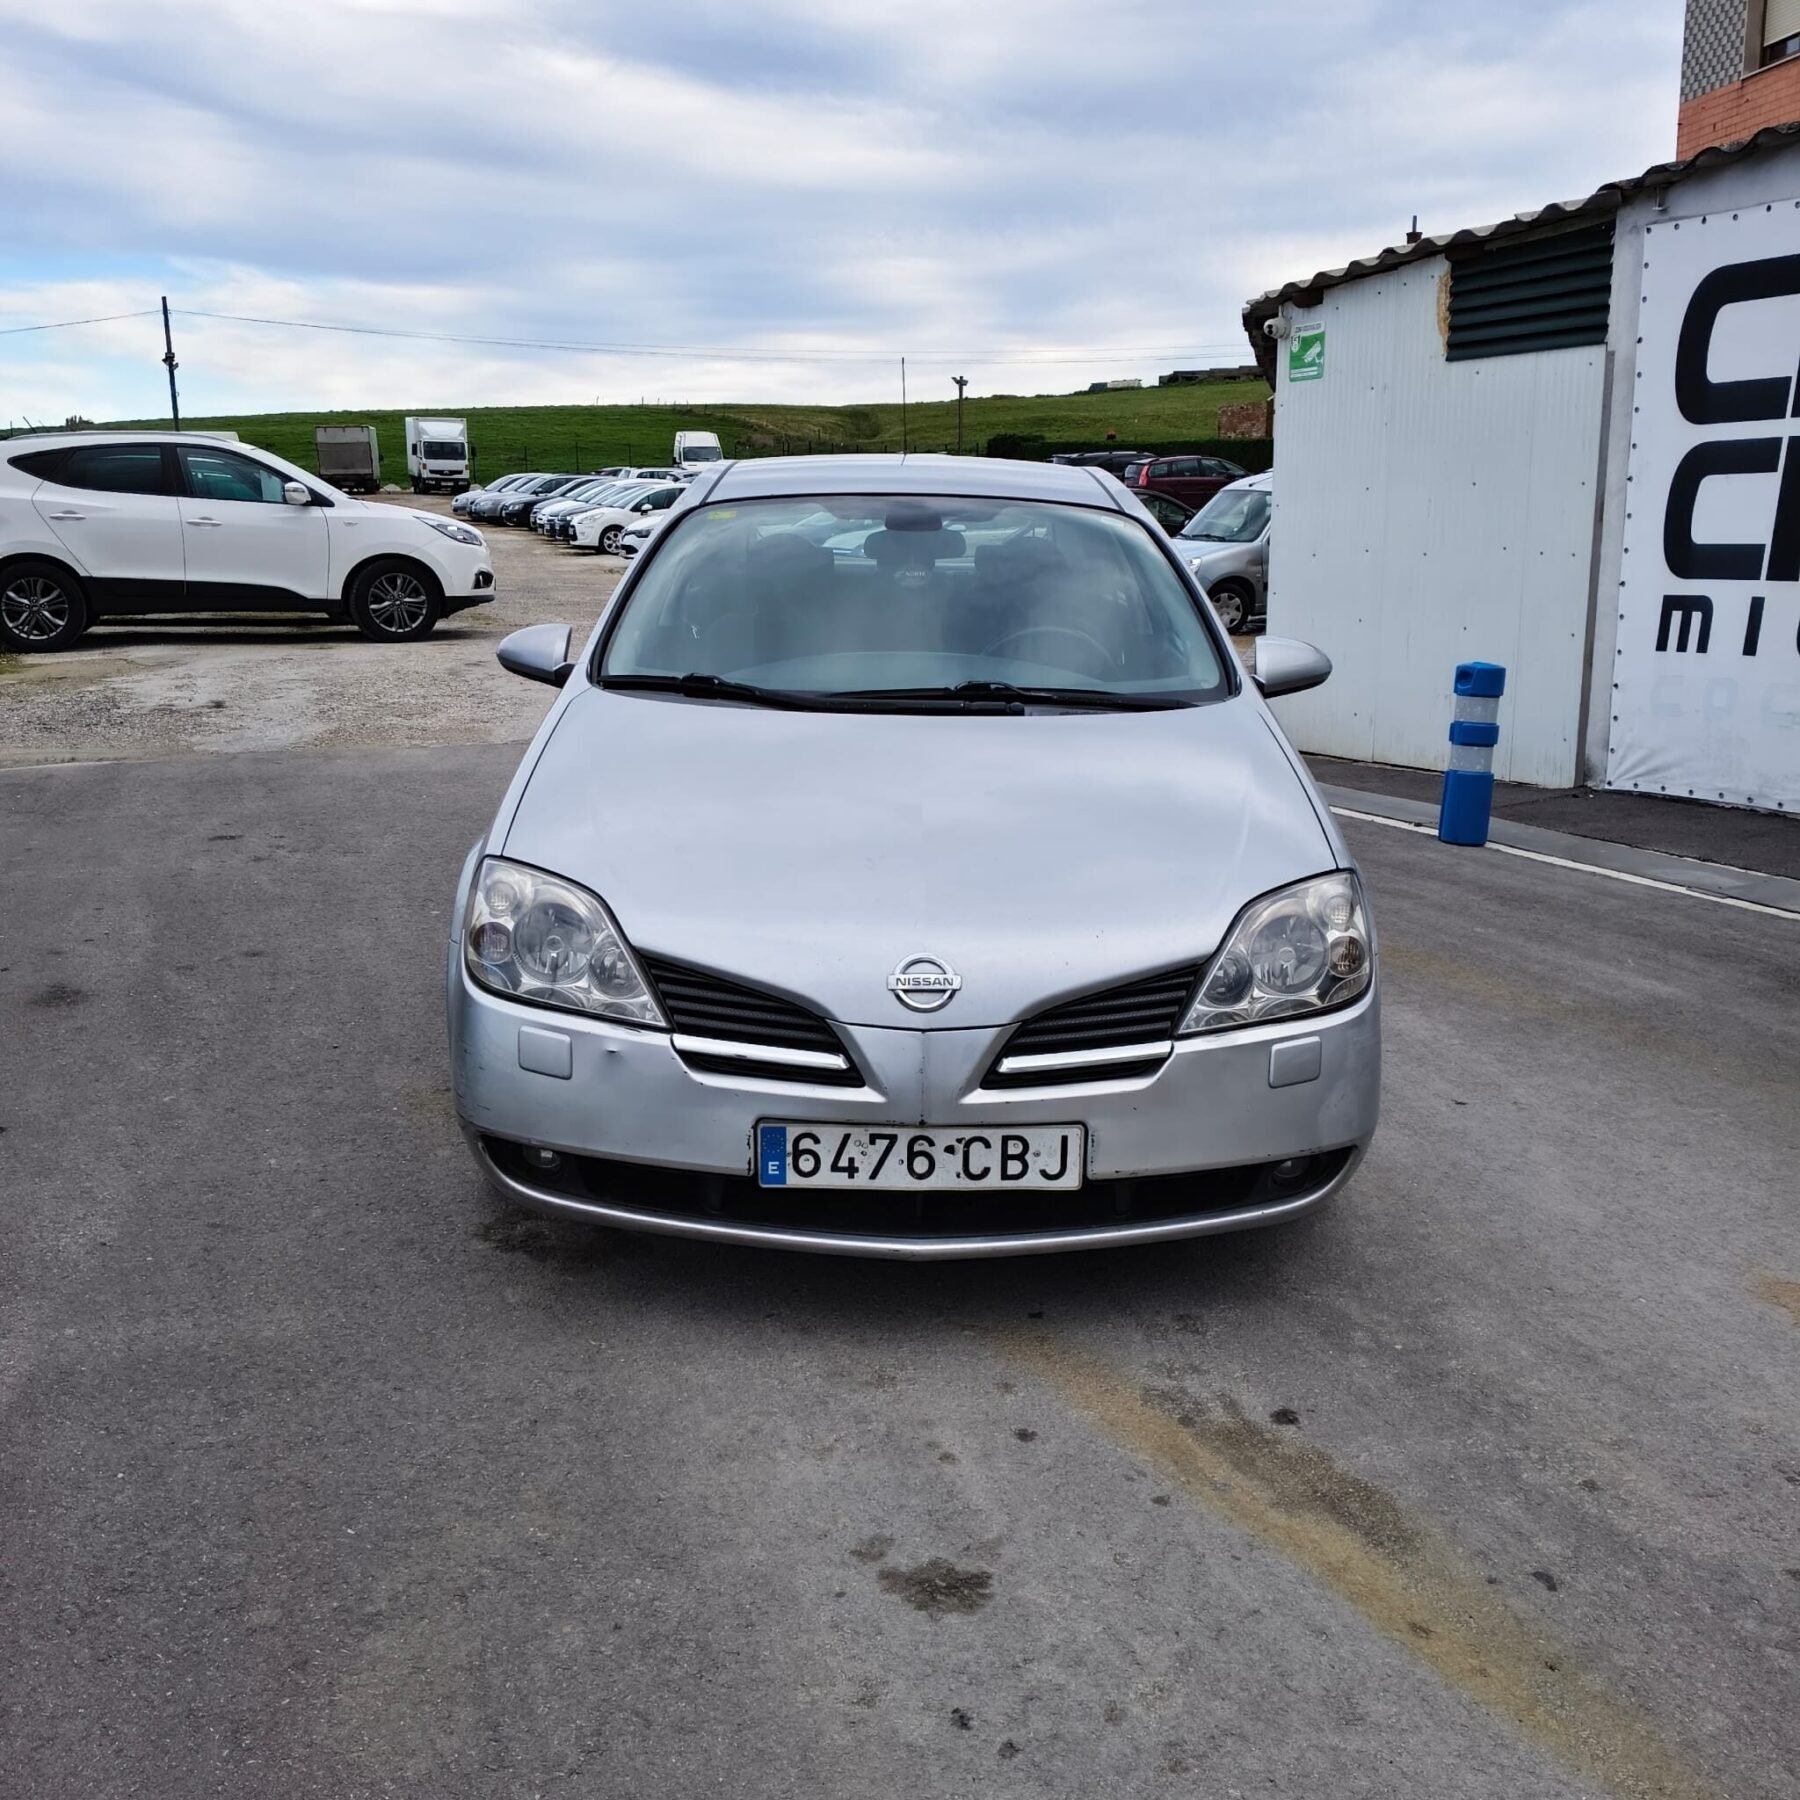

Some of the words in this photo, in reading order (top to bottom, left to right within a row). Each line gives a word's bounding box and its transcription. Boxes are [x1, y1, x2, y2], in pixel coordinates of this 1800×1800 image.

[895, 977, 954, 987] NISSAN
[767, 1161, 780, 1175] E
[791, 1132, 936, 1181] 6476
[961, 1134, 1069, 1181] CBJ
